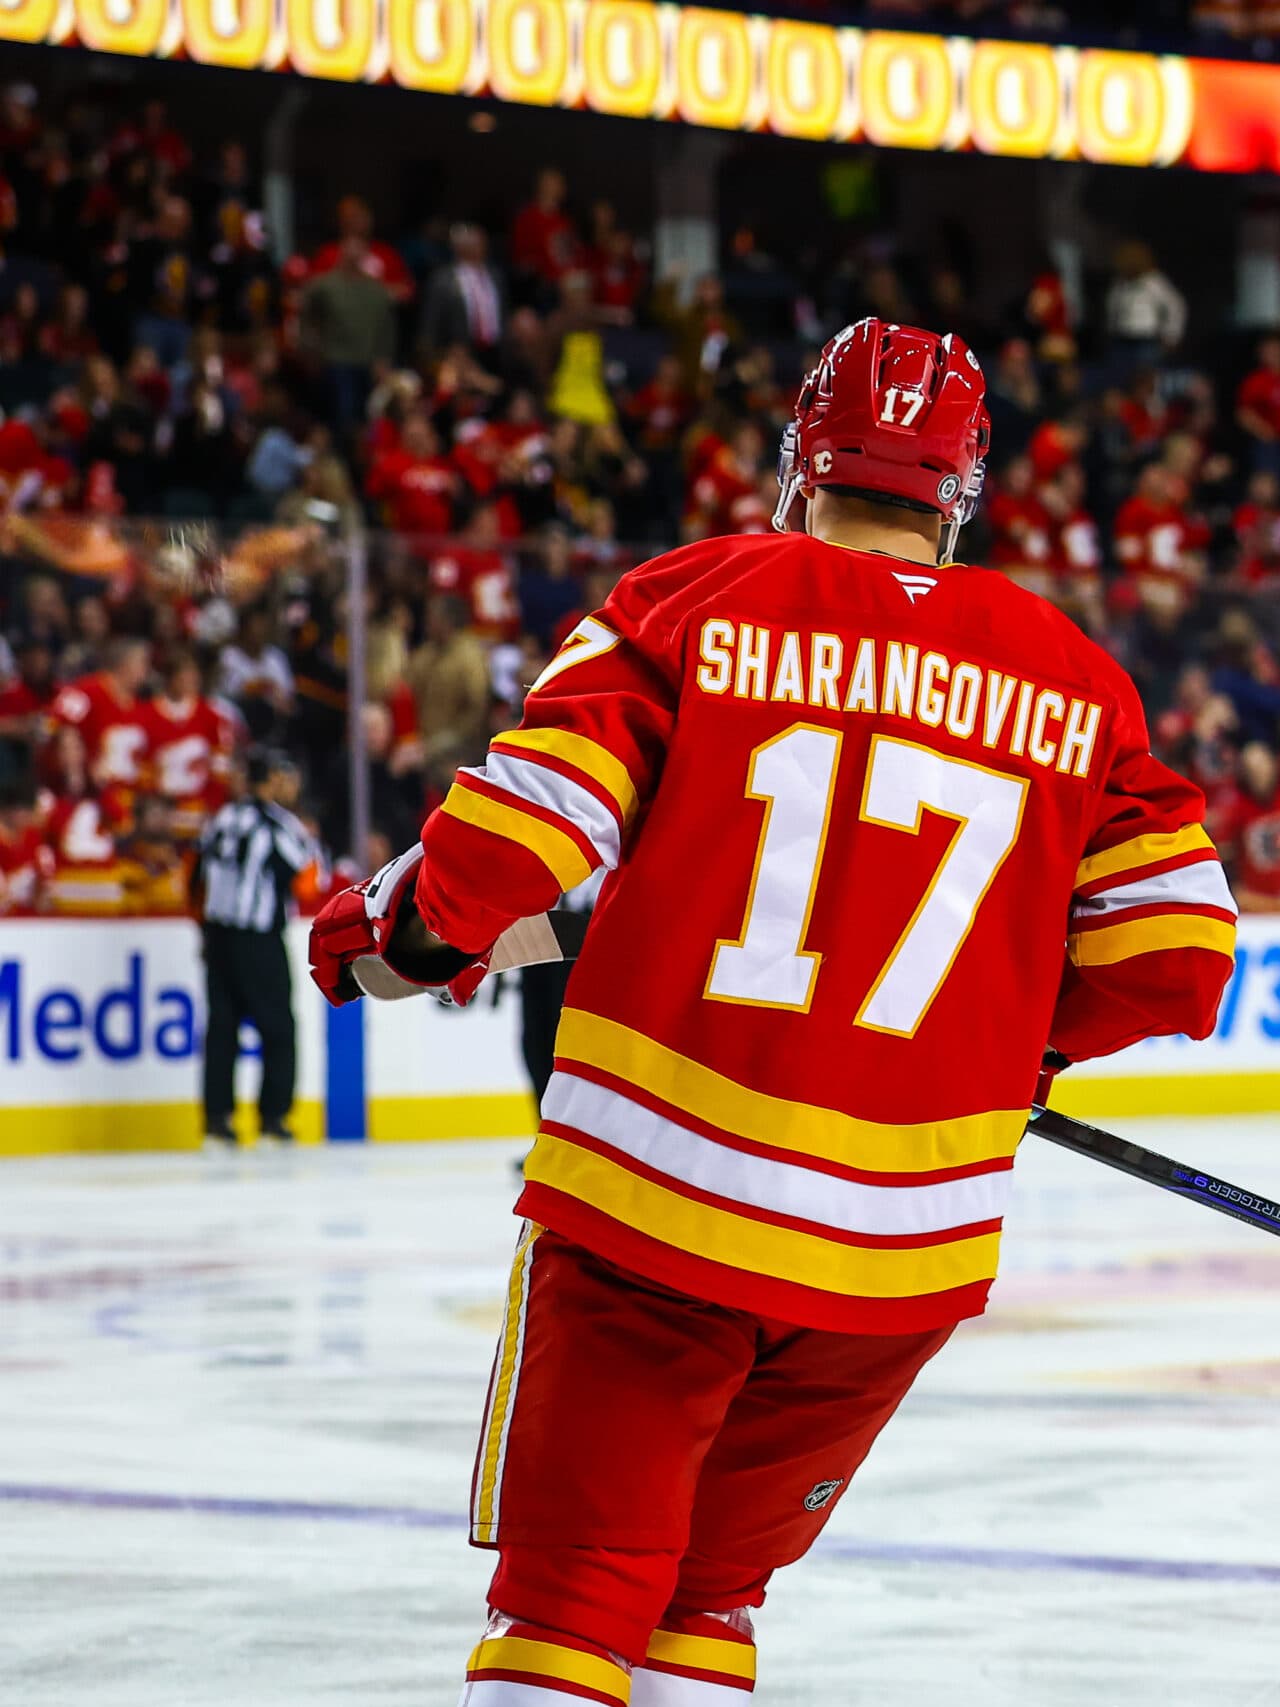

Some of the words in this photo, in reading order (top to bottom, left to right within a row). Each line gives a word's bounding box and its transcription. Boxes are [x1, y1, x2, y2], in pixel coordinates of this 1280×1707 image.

[879, 388, 924, 426] 17
[528, 616, 624, 693] 7
[697, 619, 1102, 777] SHARANGOVICH
[702, 721, 1030, 1039] 17
